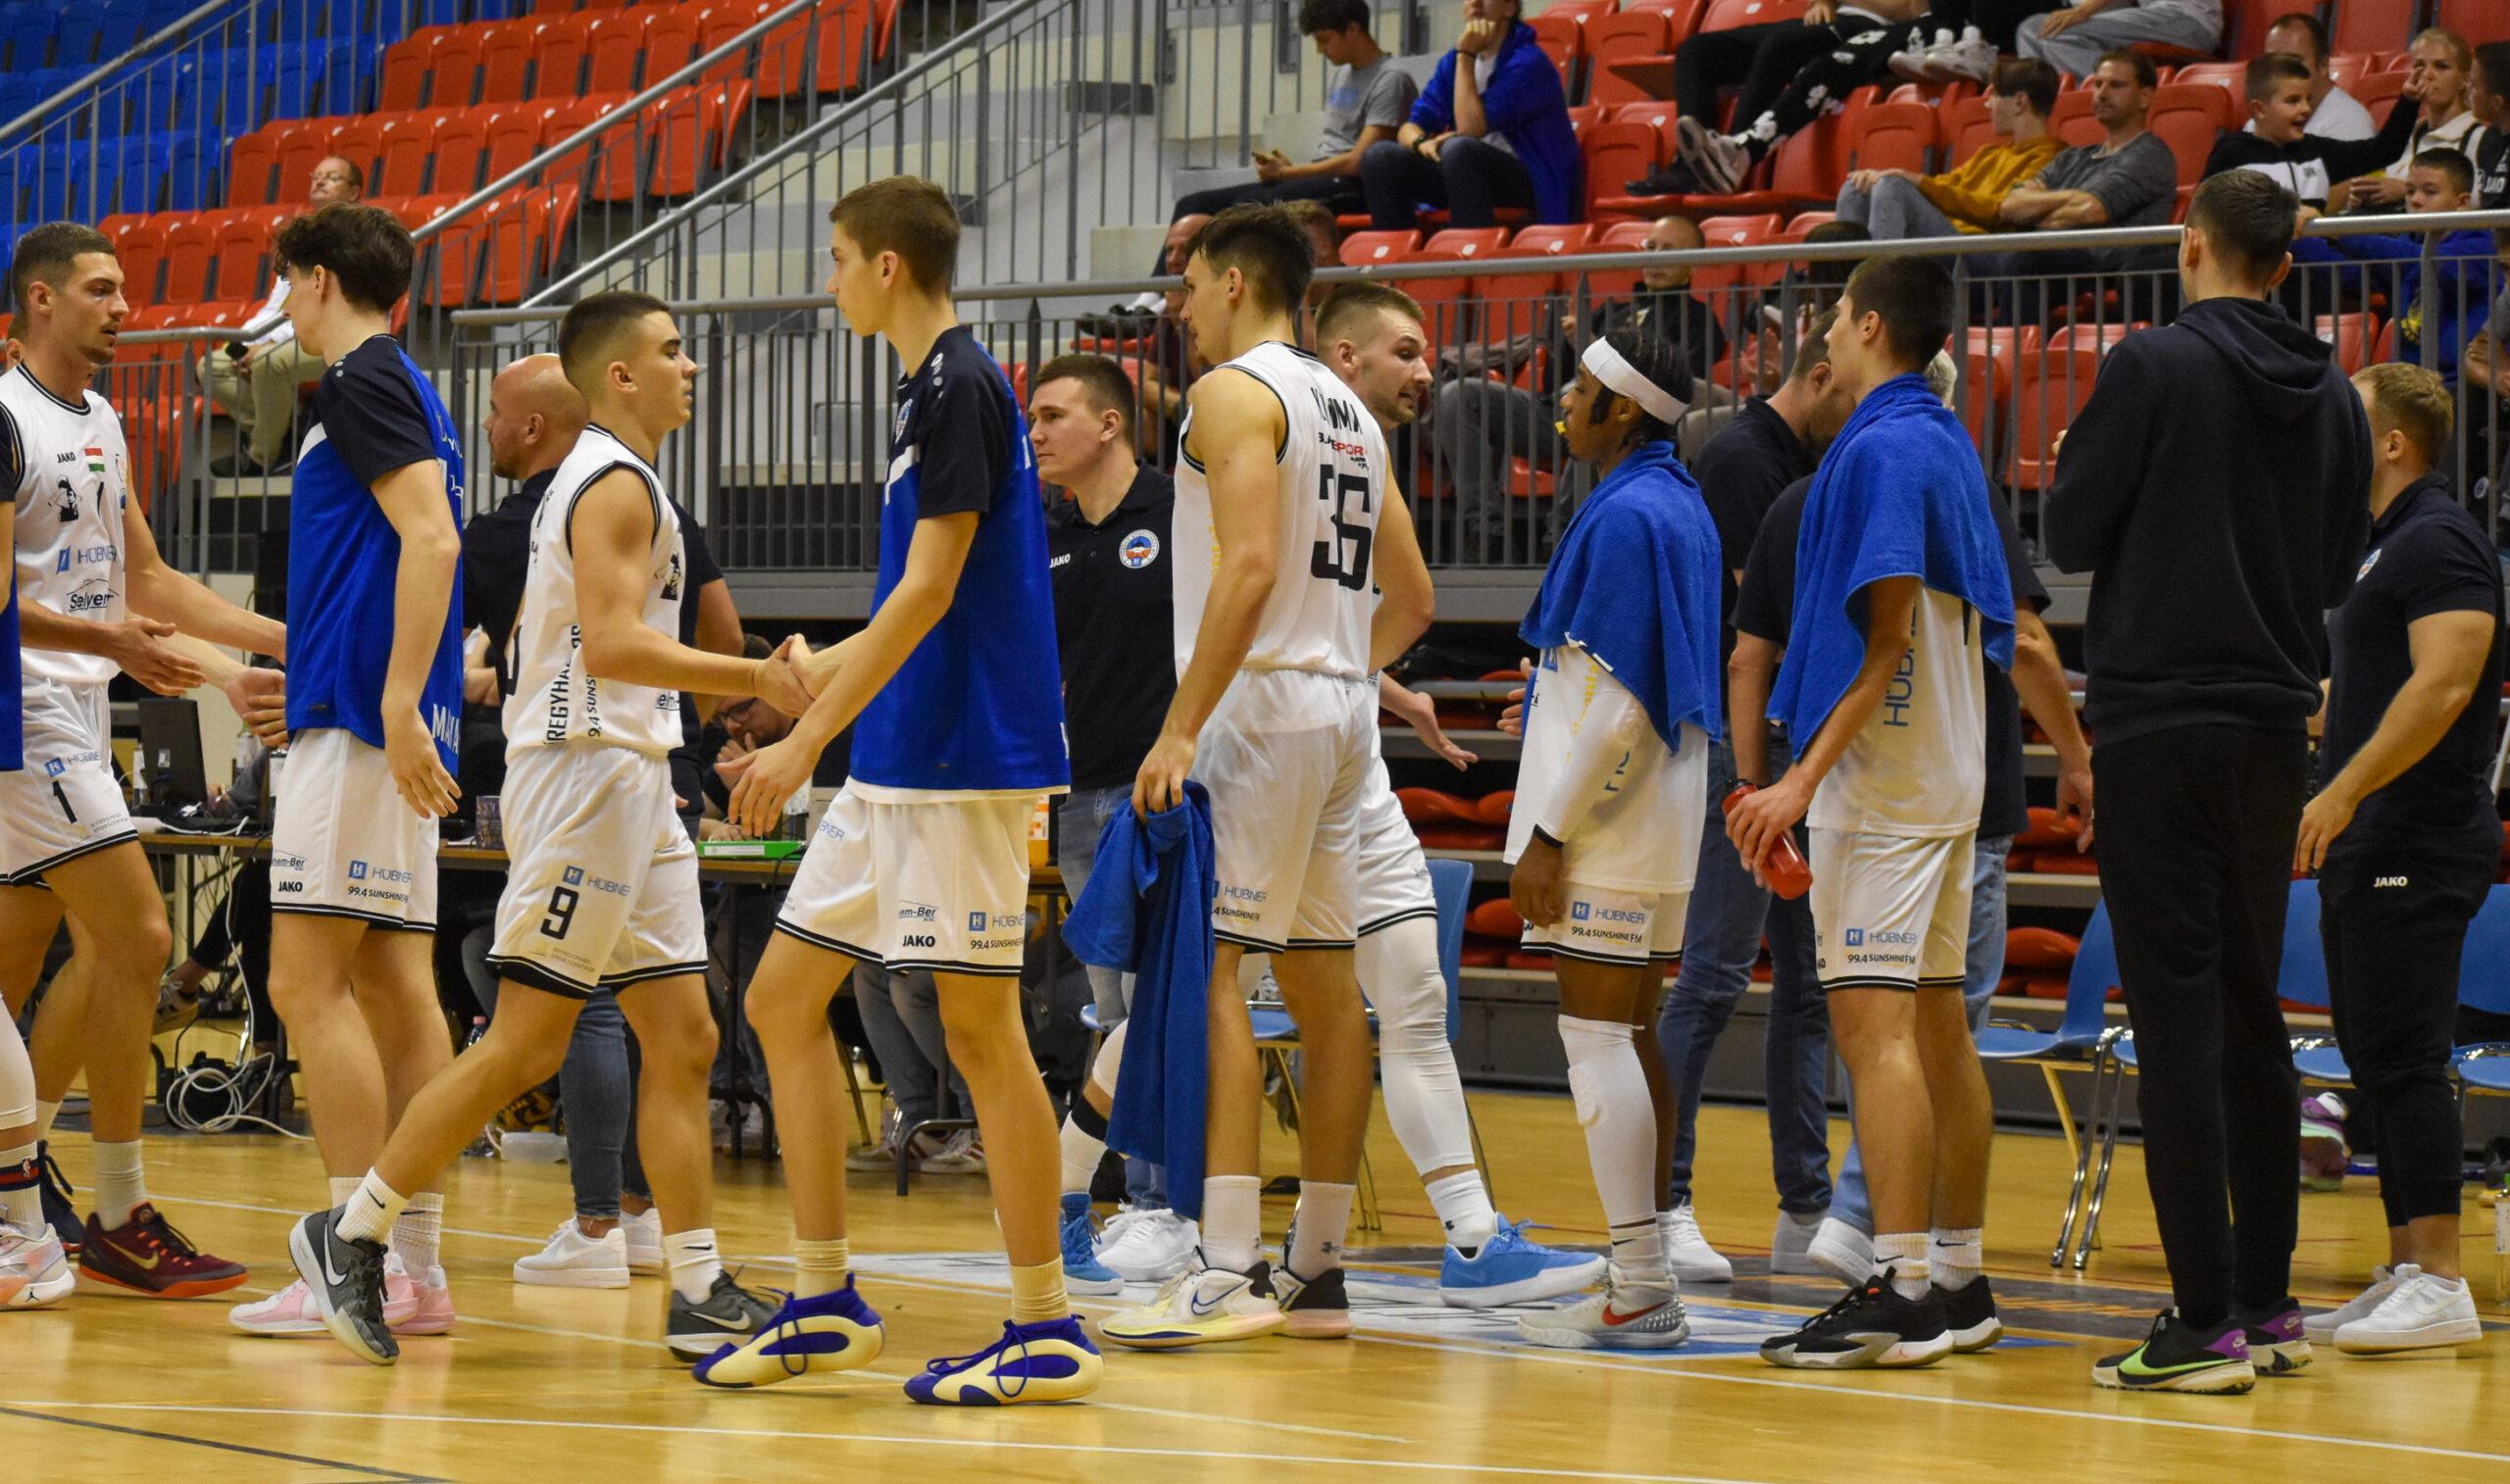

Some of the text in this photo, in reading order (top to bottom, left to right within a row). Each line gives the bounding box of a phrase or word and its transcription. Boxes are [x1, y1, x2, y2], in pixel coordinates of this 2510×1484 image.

[57, 451, 75, 464] JAKO
[1049, 553, 1071, 569] JAKO
[52, 780, 77, 823] 1
[278, 881, 303, 892] JAKO
[2374, 875, 2408, 888] JAKO
[347, 885, 367, 897] 99.4
[540, 886, 579, 940] 9
[1572, 926, 1590, 937] 99.4
[1592, 929, 1629, 940] SUNSHINE
[903, 936, 935, 947] JAKO
[971, 940, 988, 950] 99.4
[1847, 954, 1867, 964] 99.4
